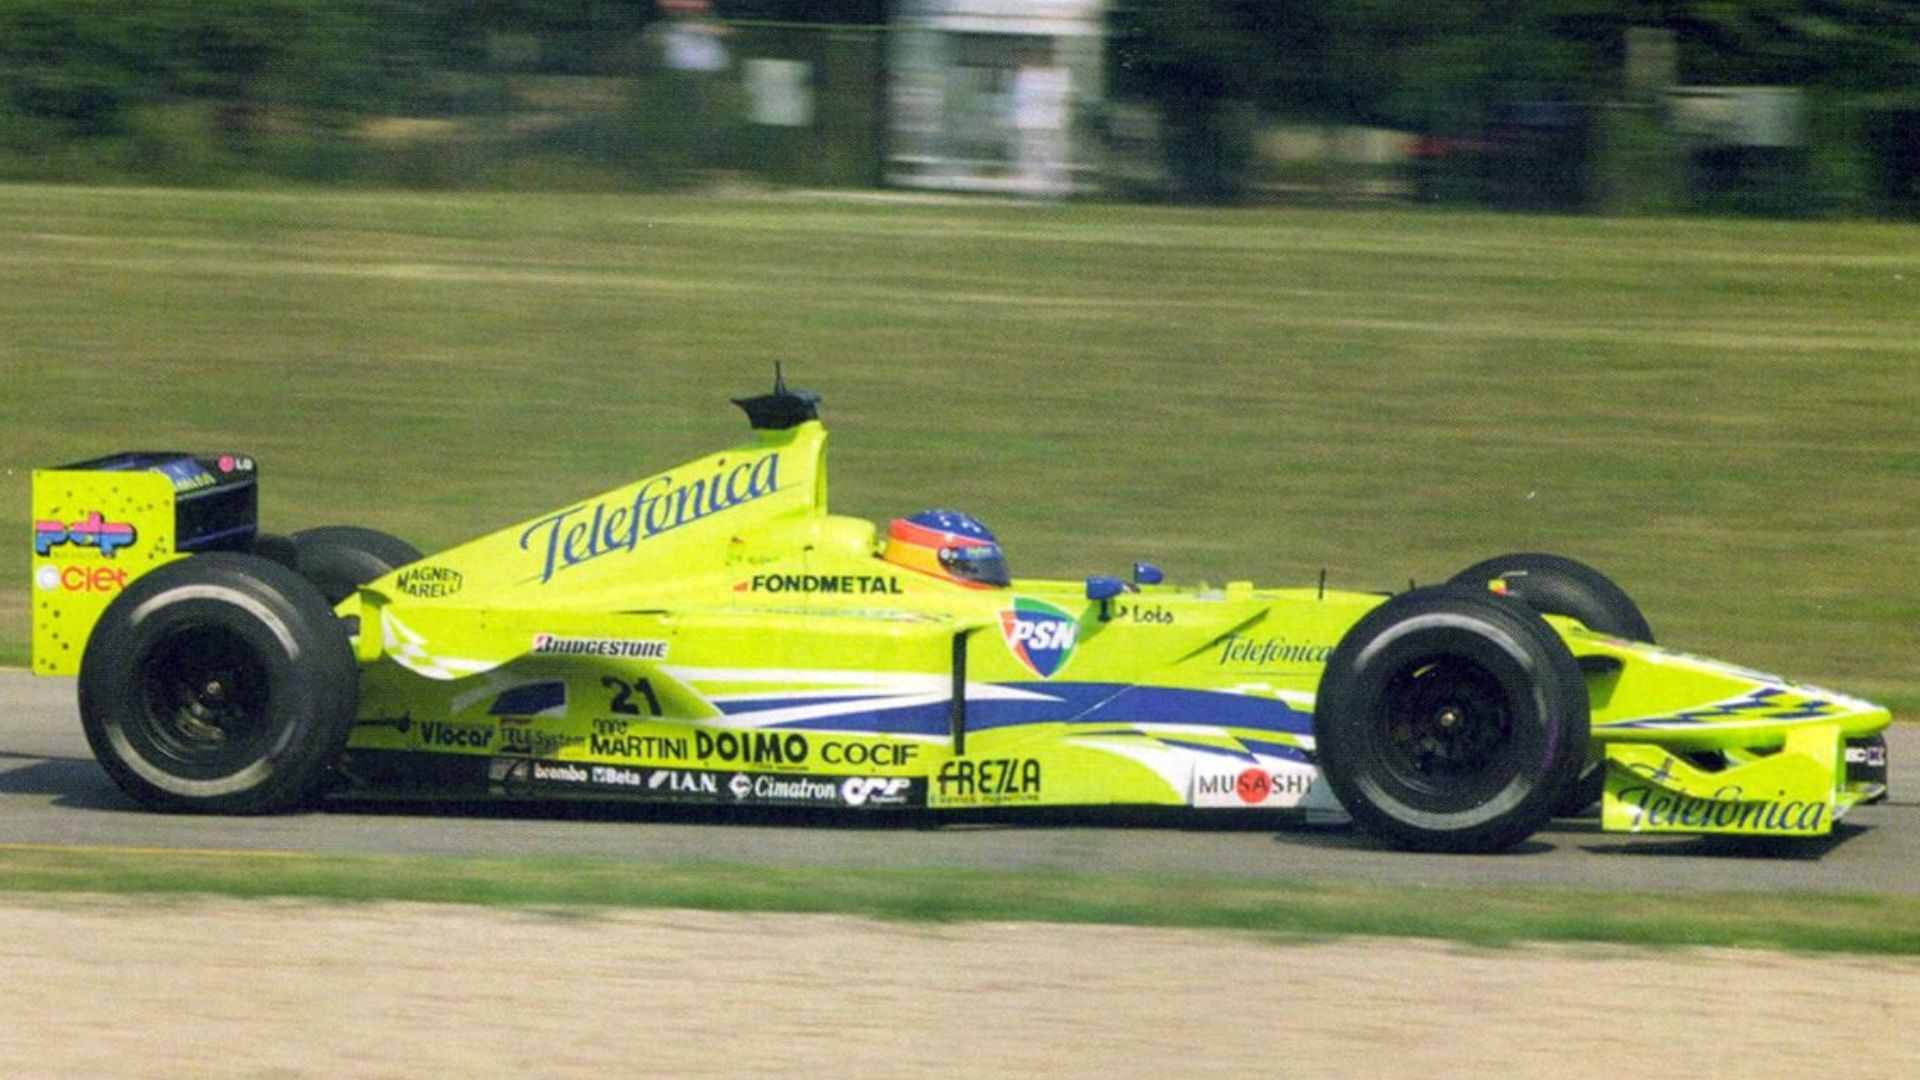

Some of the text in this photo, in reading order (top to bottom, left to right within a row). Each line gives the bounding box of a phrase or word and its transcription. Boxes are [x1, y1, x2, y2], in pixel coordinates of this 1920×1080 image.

[235, 457, 253, 471] LG
[750, 574, 904, 594] FONDMETAL
[1133, 604, 1173, 624] Lois
[535, 635, 668, 658] BRIDGESTONE
[1009, 619, 1079, 650] PSN
[601, 674, 663, 718] 21
[590, 732, 688, 760] MARTINI
[695, 728, 809, 764] DOIMO
[820, 741, 919, 766] COCIF
[754, 775, 837, 799] Cimatron
[1198, 773, 1313, 795] MUSASHI
